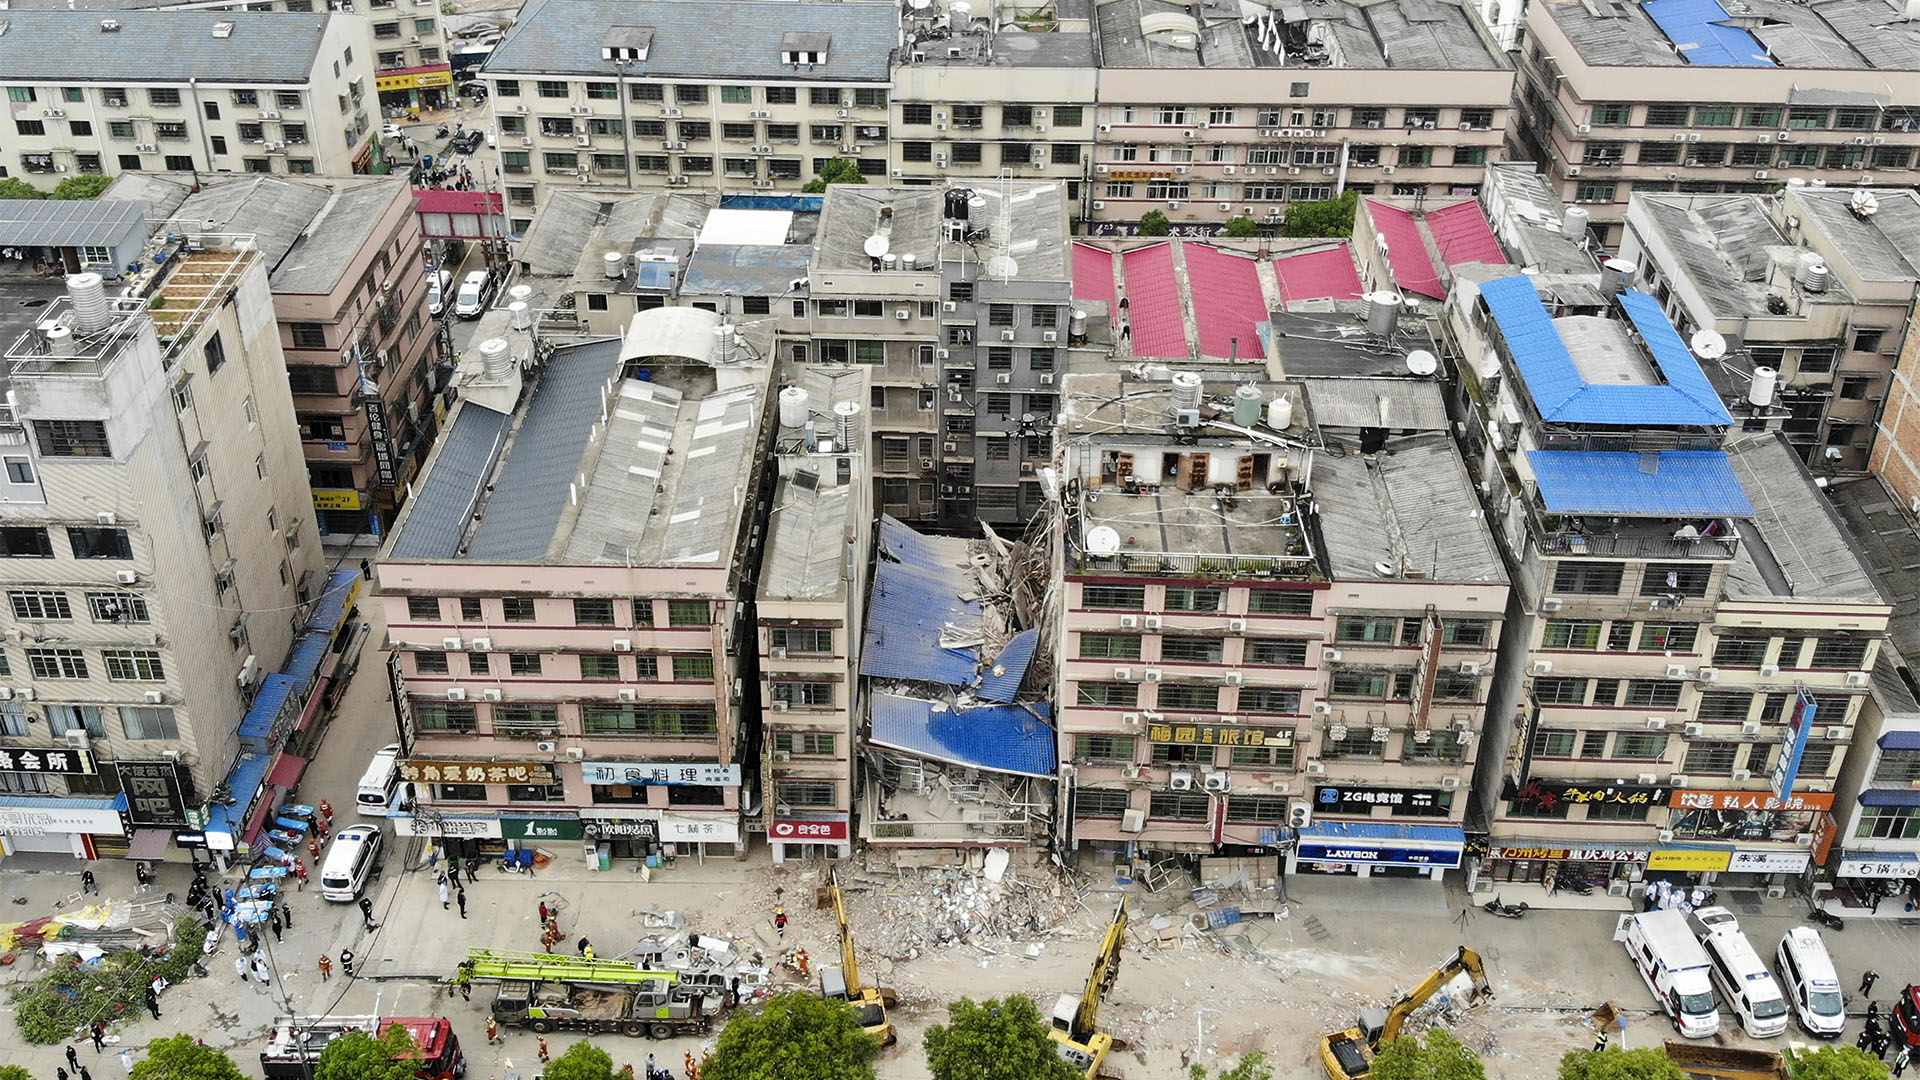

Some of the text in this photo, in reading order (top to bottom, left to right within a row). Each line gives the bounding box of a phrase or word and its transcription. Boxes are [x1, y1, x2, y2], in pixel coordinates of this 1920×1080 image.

[1219, 729, 1265, 746] 旅馆
[1277, 731, 1293, 739] 4F
[596, 767, 698, 782] 初食料理
[130, 778, 176, 815] 网吧
[1326, 849, 1379, 860] LAWSON
